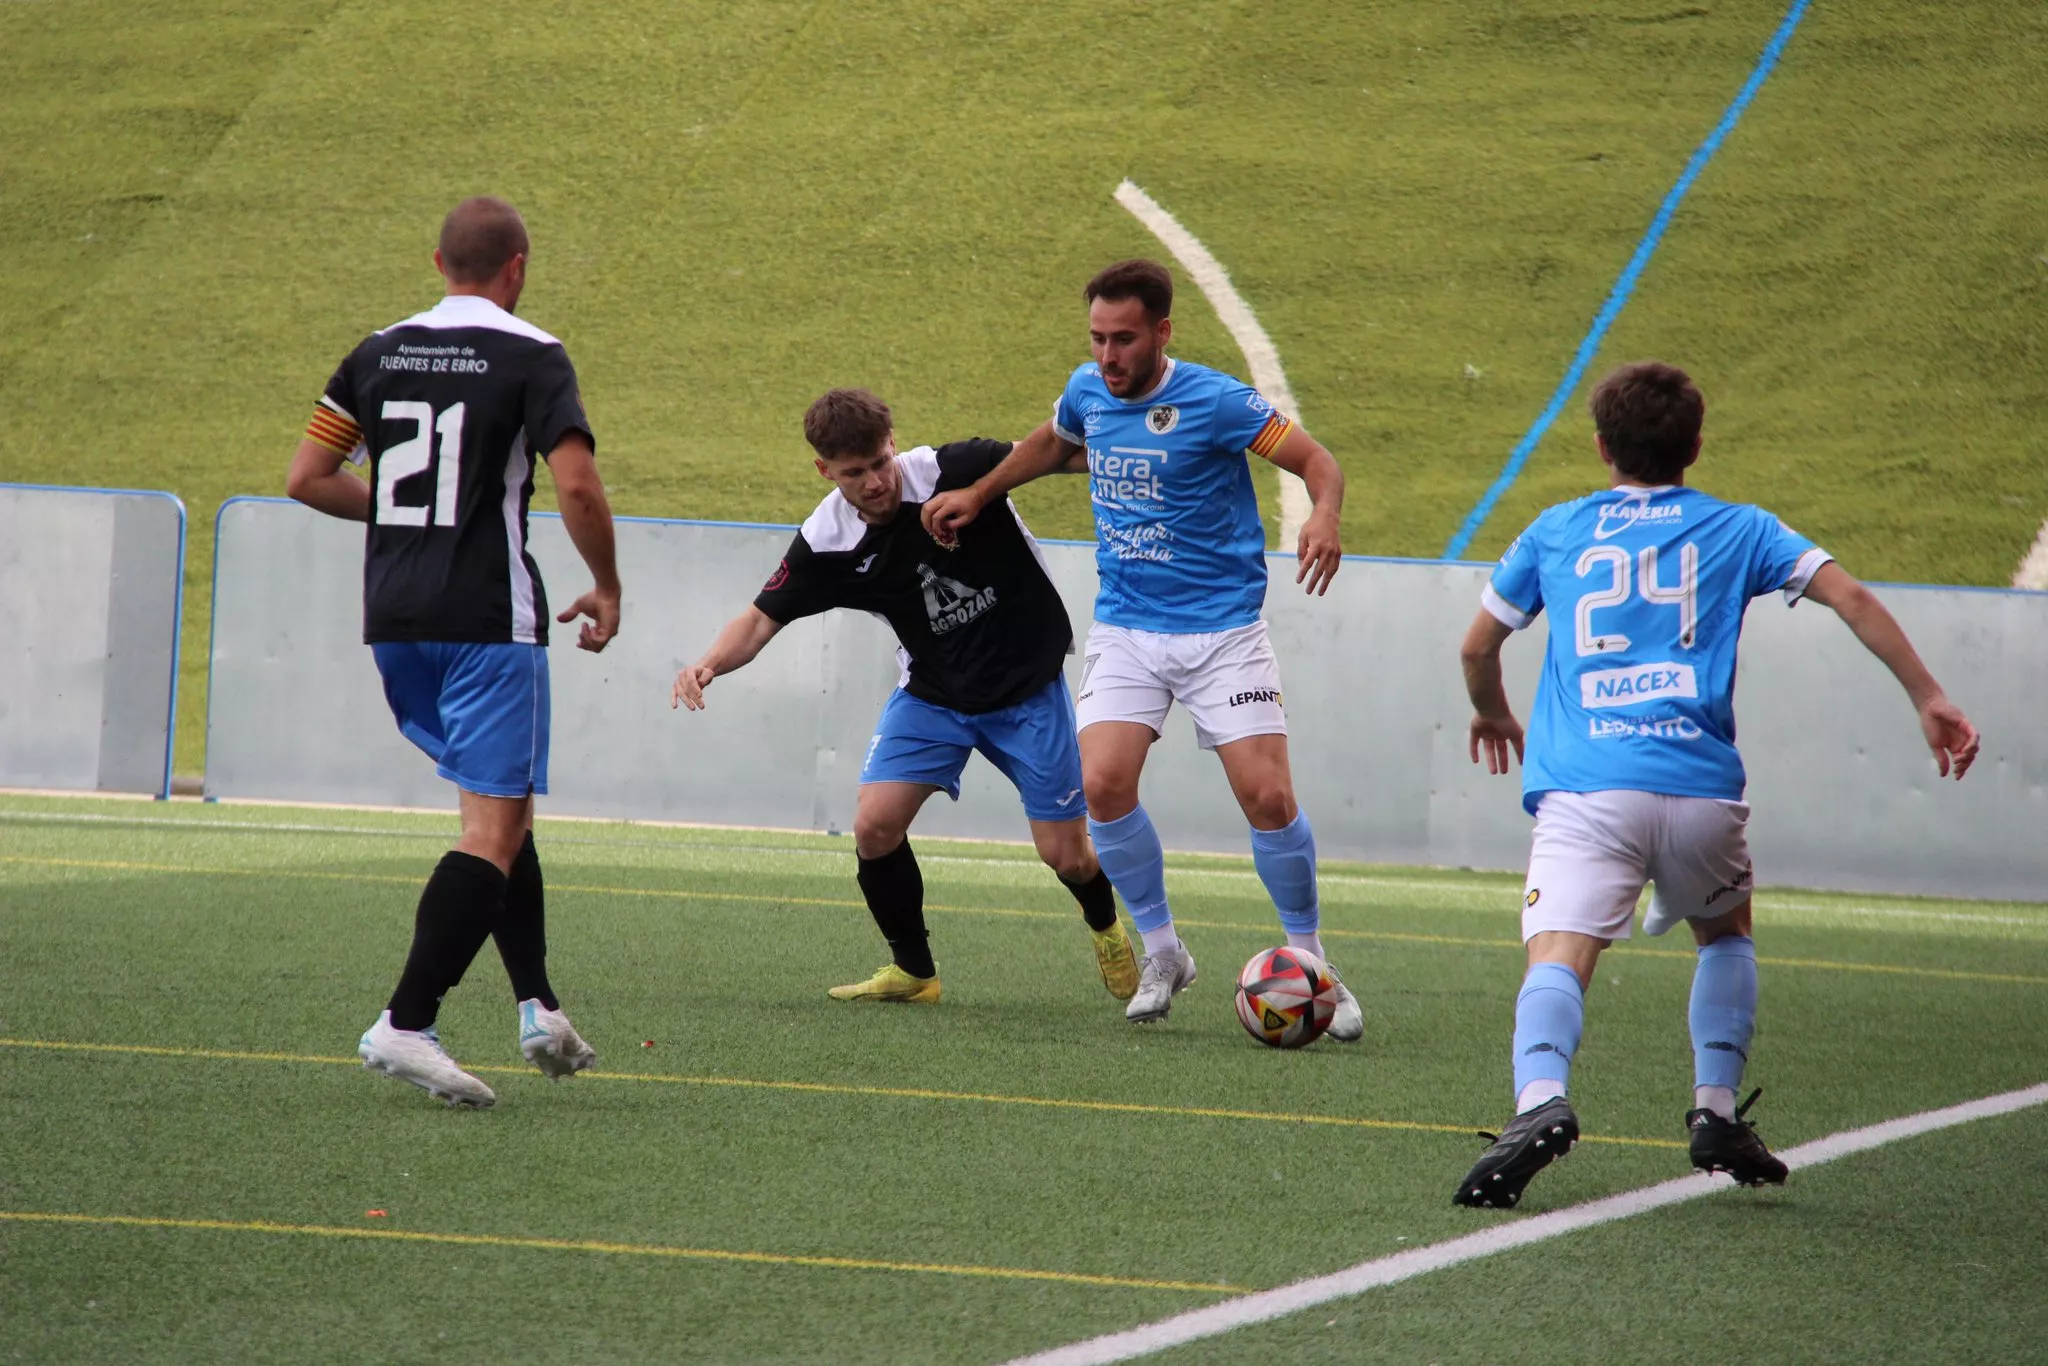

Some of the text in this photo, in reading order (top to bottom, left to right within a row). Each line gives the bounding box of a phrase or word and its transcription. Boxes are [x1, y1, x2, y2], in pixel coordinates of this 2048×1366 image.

[397, 343, 475, 356] Ayuntamiento de
[380, 355, 488, 373] FUENTES DE EBRO
[375, 400, 465, 527] 21
[1096, 475, 1164, 501] meat
[930, 586, 997, 632] AGROZAR
[1574, 541, 1699, 657] 24
[1595, 670, 1680, 698] NACEX
